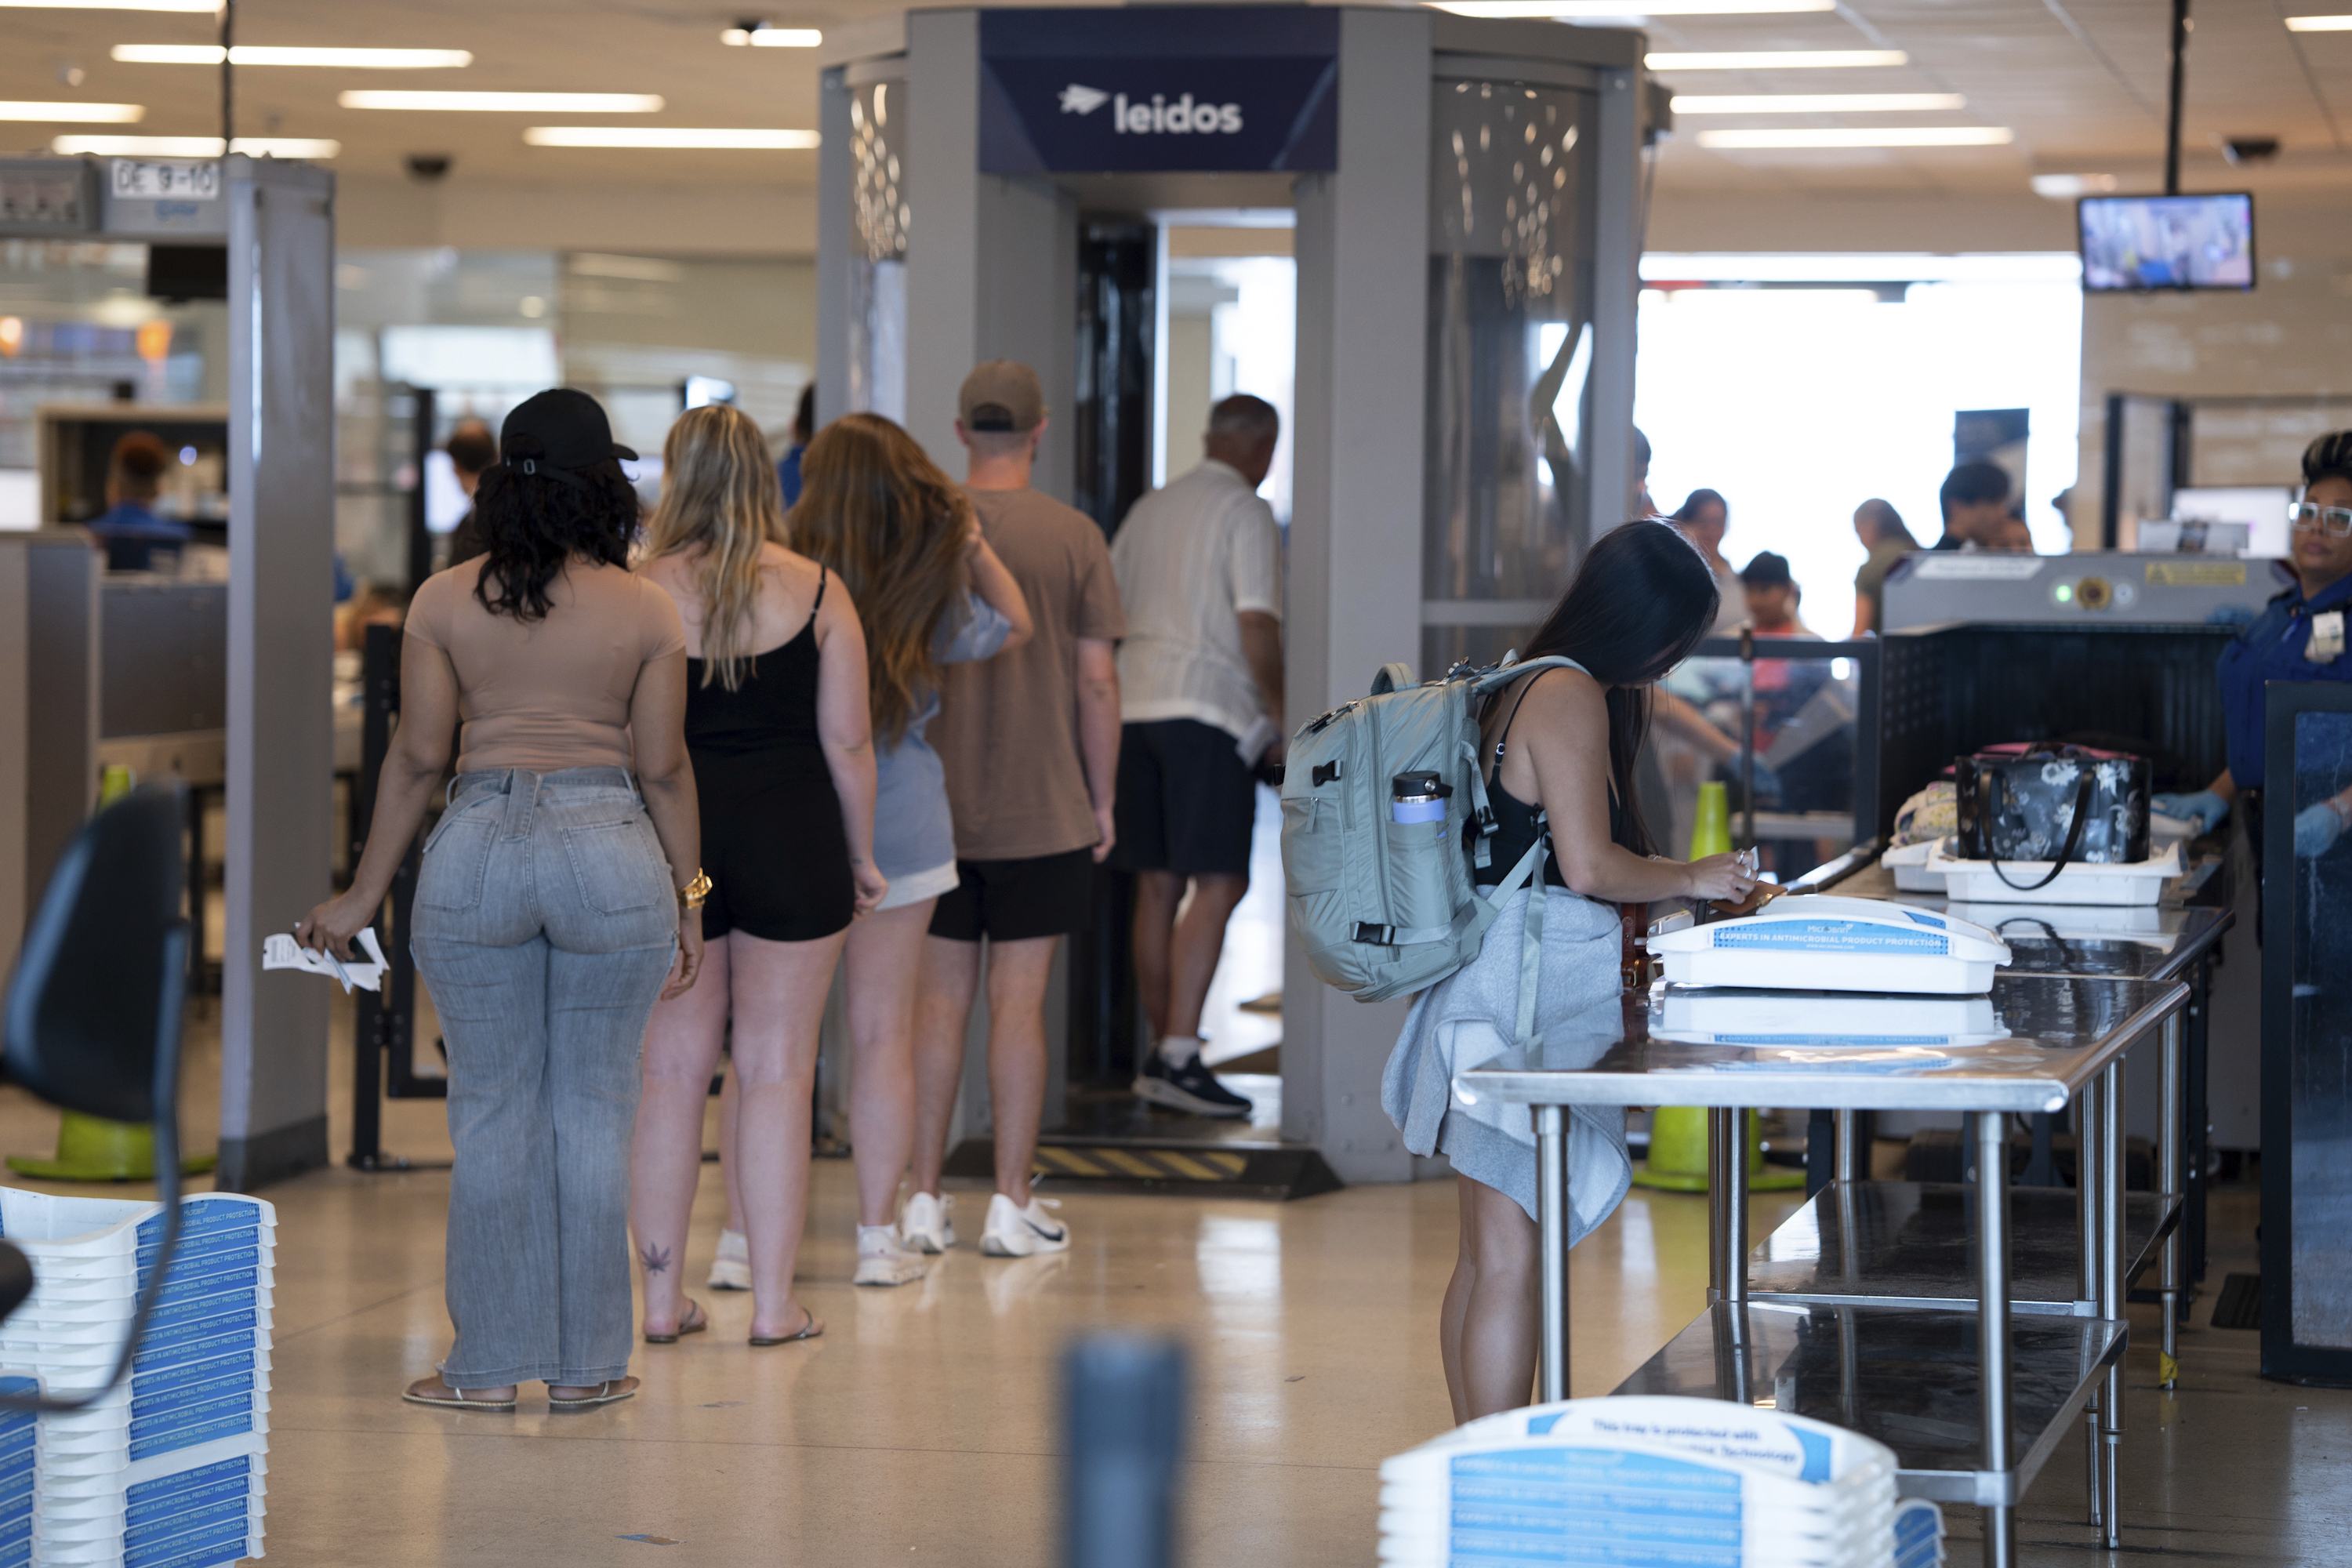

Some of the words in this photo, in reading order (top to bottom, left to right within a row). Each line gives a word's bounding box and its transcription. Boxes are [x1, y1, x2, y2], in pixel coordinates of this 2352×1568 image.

[1115, 93, 1243, 133] leidos
[1772, 935, 1839, 943] ANTIMICROBIAL
[203, 1214, 225, 1224] PRODUCT
[226, 1209, 256, 1220] PROTECTION
[202, 1235, 224, 1245] PRODUCT
[225, 1230, 254, 1241] PROTECTION
[165, 1260, 201, 1274] ANTIMICROBIAL
[201, 1256, 223, 1266] PRODUCT
[224, 1250, 254, 1261] PROTECTION
[164, 1282, 200, 1295] ANTIMICROBIAL
[201, 1277, 223, 1287] PRODUCT
[223, 1271, 253, 1283] PROTECTION
[163, 1302, 199, 1317] ANTIMICROBIAL
[200, 1298, 222, 1308] PRODUCT
[223, 1291, 252, 1304] PROTECTION
[163, 1325, 199, 1339] ANTIMICROBIAL
[200, 1319, 222, 1331] PRODUCT
[223, 1312, 252, 1326] PROTECTION
[162, 1343, 198, 1358] ANTIMICROBIAL
[198, 1339, 220, 1349] PRODUCT
[221, 1334, 251, 1345] PROTECTION
[161, 1365, 197, 1381] ANTIMICROBIAL
[198, 1360, 220, 1371] PRODUCT
[220, 1354, 250, 1367] PROTECTION
[160, 1386, 196, 1402] ANTIMICROBIAL
[197, 1381, 219, 1392] PRODUCT
[220, 1376, 249, 1388] PROTECTION
[158, 1408, 194, 1423] ANTIMICROBIAL
[195, 1403, 218, 1414] PRODUCT
[219, 1396, 248, 1409] PROTECTION
[158, 1428, 194, 1443] ANTIMICROBIAL
[195, 1423, 217, 1434] PRODUCT
[218, 1417, 248, 1429] PROTECTION
[156, 1472, 192, 1488] ANTIMICROBIAL
[193, 1465, 215, 1477] PRODUCT
[216, 1458, 245, 1472] PROTECTION
[155, 1493, 191, 1509] ANTIMICROBIAL
[191, 1487, 214, 1499] PRODUCT
[215, 1480, 245, 1493] PROTECTION
[153, 1514, 190, 1530] ANTIMICROBIAL
[190, 1508, 212, 1520] PRODUCT
[213, 1500, 243, 1513] PROTECTION
[153, 1536, 189, 1553] ANTIMICROBIAL
[190, 1530, 212, 1541] PRODUCT
[213, 1522, 244, 1536] PROTECTION
[189, 1549, 212, 1561] PRODUCT
[212, 1541, 242, 1555] PROTECTION
